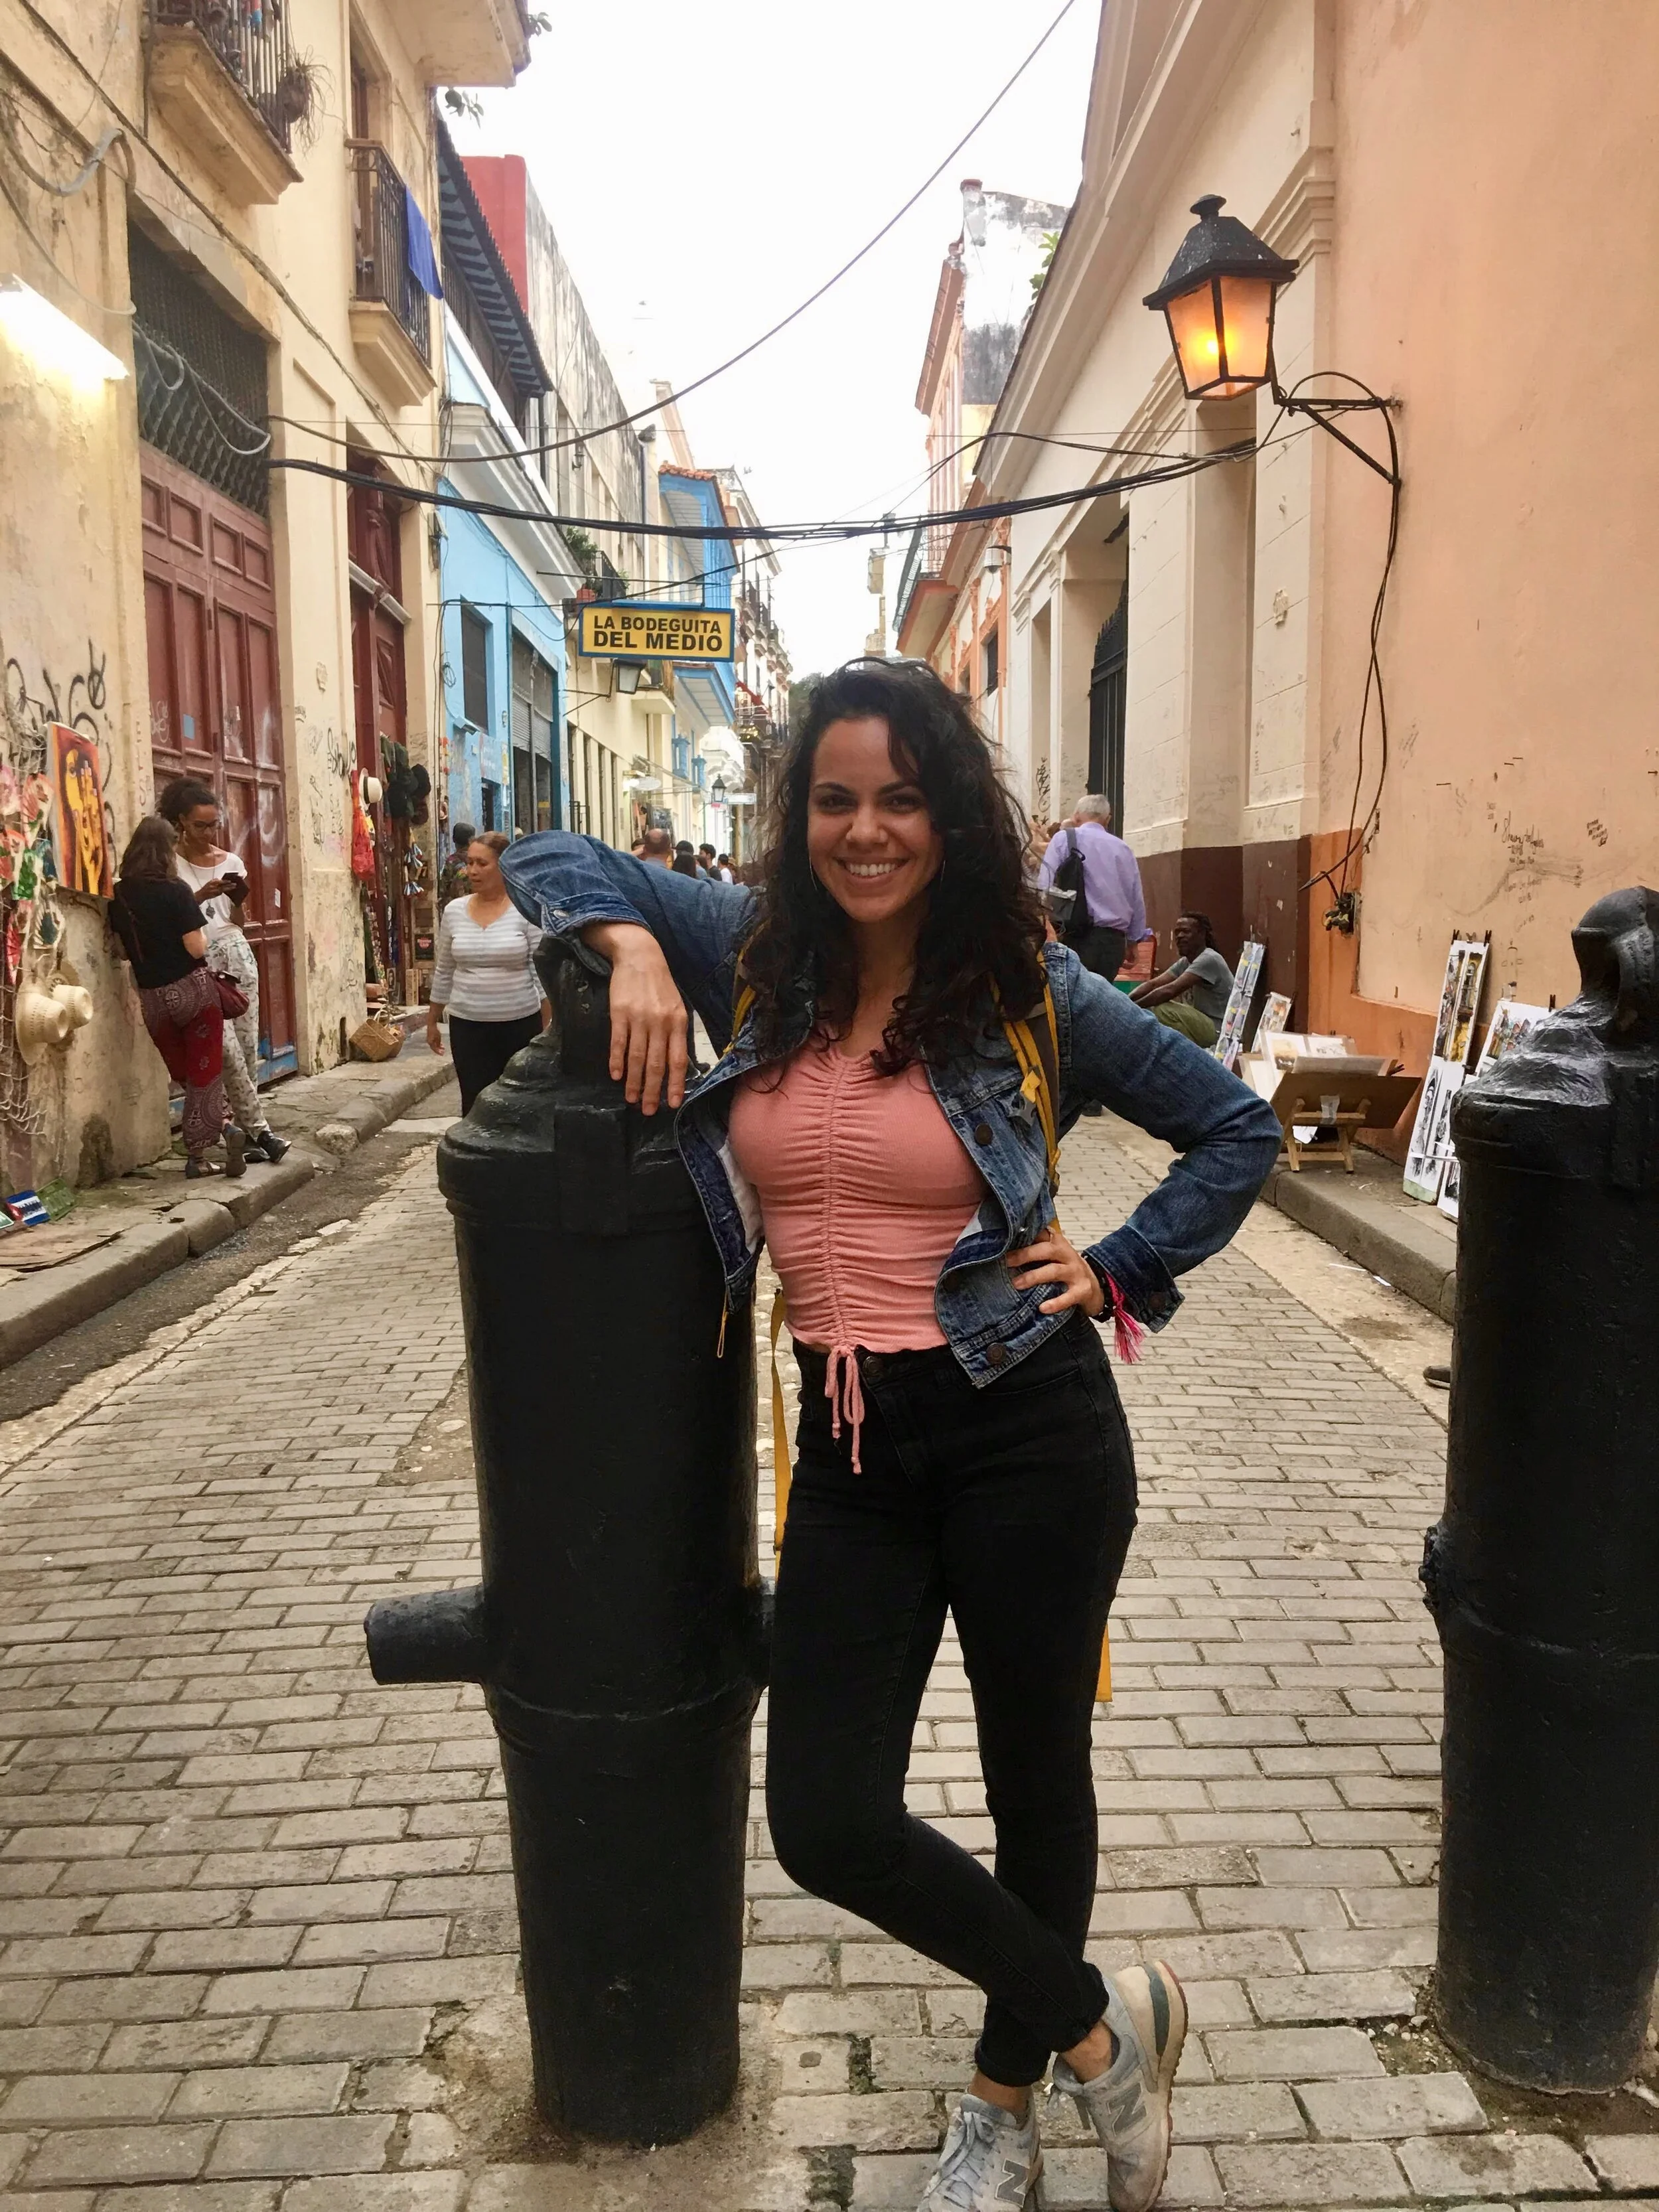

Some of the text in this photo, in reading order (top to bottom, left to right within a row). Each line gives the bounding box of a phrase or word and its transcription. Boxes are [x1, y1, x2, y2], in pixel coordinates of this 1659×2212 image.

[594, 615, 721, 634] LA BODEGUITA
[594, 631, 722, 652] DEL MEDIO
